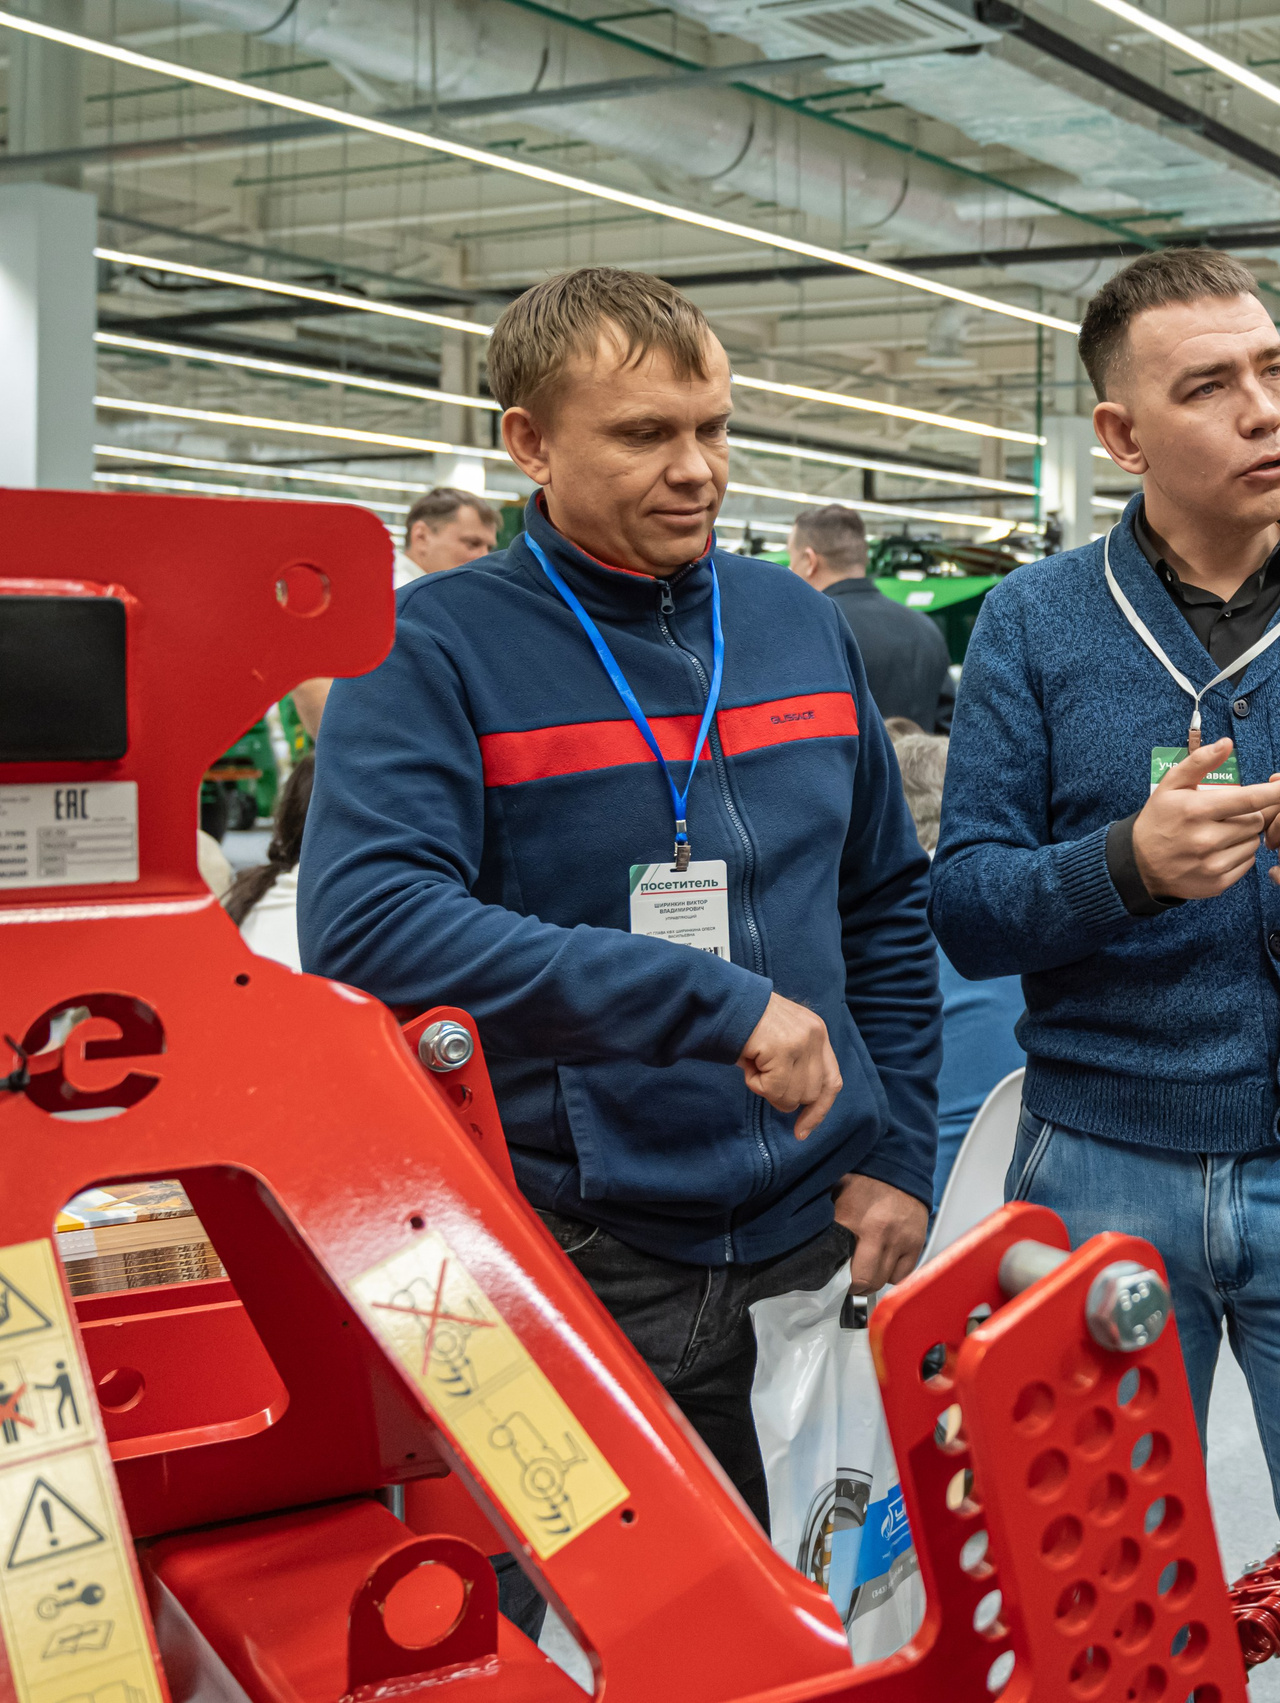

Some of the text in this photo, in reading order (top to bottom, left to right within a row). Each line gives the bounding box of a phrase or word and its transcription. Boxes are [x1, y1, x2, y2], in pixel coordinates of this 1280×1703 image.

[1205, 772, 1233, 780] авки
[54, 788, 89, 820] EAC
[640, 879, 719, 891] посетитель
[659, 906, 705, 914] ВЛАДИМИРОВИЧ
